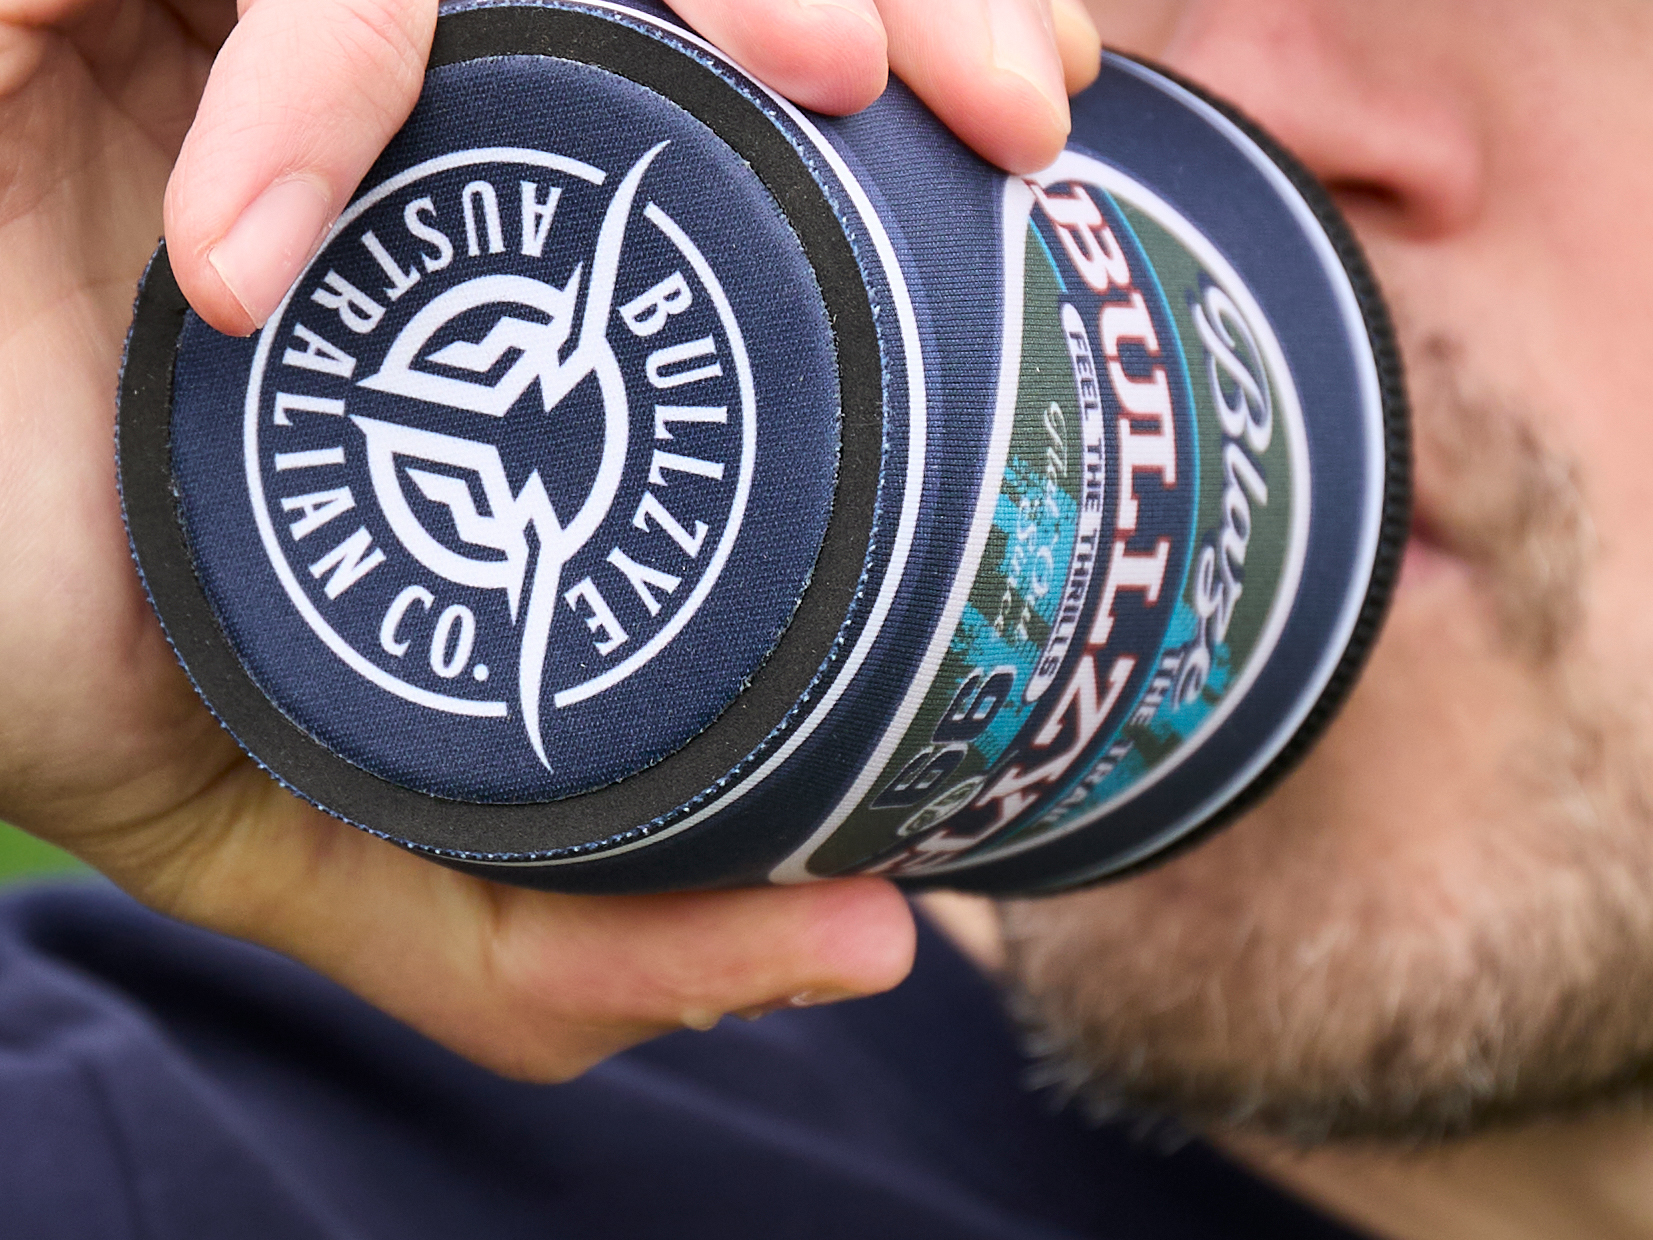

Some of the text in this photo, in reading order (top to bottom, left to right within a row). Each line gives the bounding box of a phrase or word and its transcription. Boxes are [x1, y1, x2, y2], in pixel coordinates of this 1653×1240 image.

[273, 180, 562, 682] AUSTRALIAN CO.
[564, 270, 729, 656] BULLZYE
[1038, 330, 1103, 679] FEEL THE THRILLS
[1190, 282, 1273, 712] Blaze
[869, 664, 1017, 809] 99
[1129, 650, 1182, 727] THE
